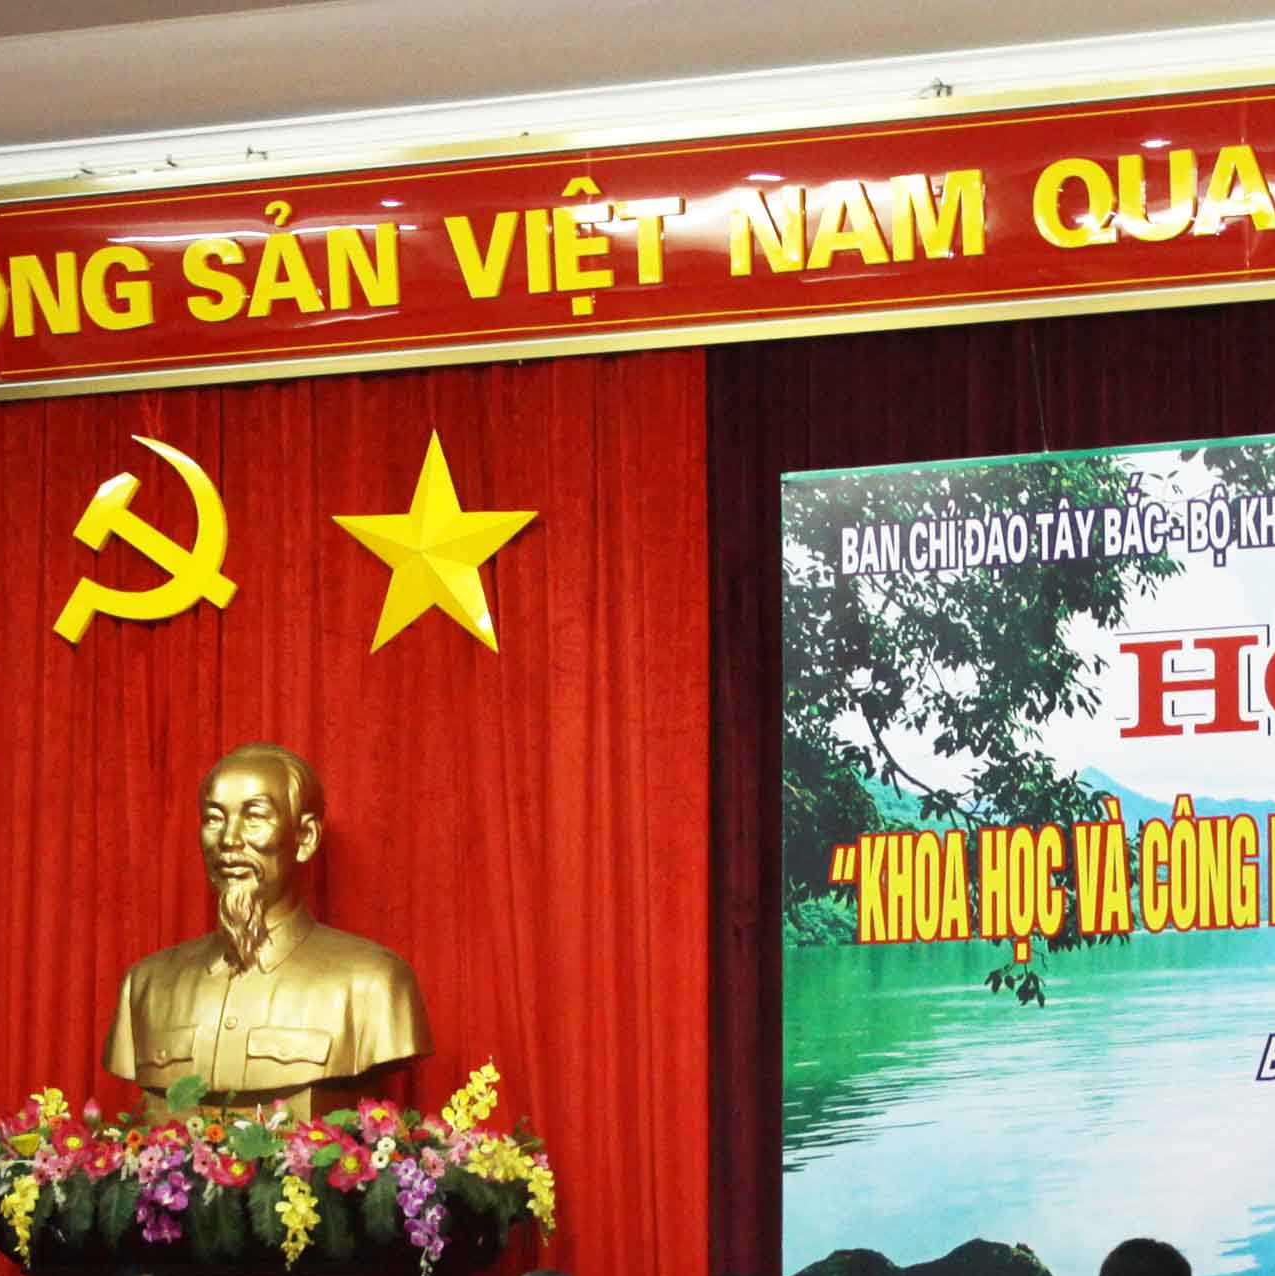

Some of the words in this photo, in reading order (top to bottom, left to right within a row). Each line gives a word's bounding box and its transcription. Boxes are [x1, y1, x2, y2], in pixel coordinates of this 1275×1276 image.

[184, 198, 401, 324] SẢN
[444, 174, 688, 317] VIỆT
[726, 167, 988, 279] NAM
[841, 522, 901, 576] BAN
[908, 499, 957, 572] CHỈ
[964, 514, 1028, 580] ĐẠO
[1036, 497, 1096, 561] TÂY
[1188, 482, 1231, 567] BỘ
[979, 824, 1067, 963] HỌC
[1075, 796, 1133, 937] VÀ
[1139, 794, 1262, 935] CÔNG
